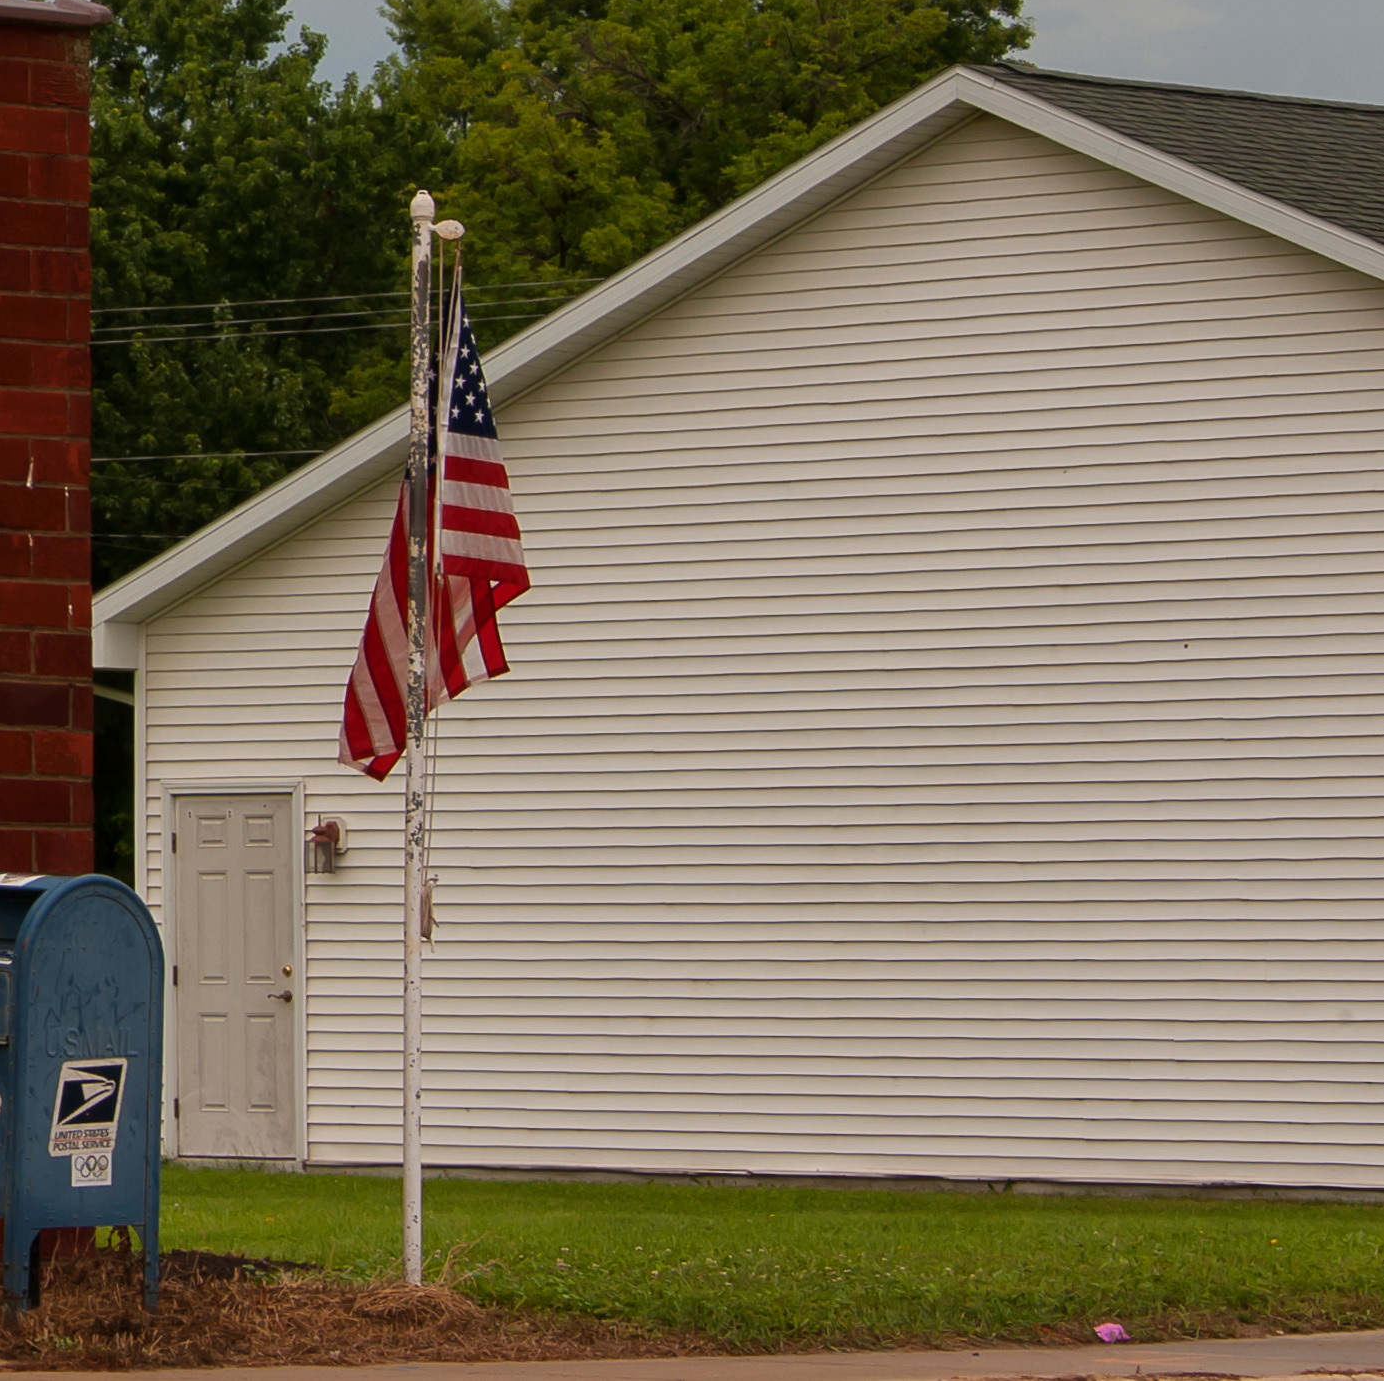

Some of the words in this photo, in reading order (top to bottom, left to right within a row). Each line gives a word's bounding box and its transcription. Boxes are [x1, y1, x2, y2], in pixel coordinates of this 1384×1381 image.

[54, 1129, 83, 1141] UNITED
[84, 1128, 110, 1139] STATES
[52, 1140, 81, 1152] POSTAL
[81, 1139, 112, 1150] SERVICE
